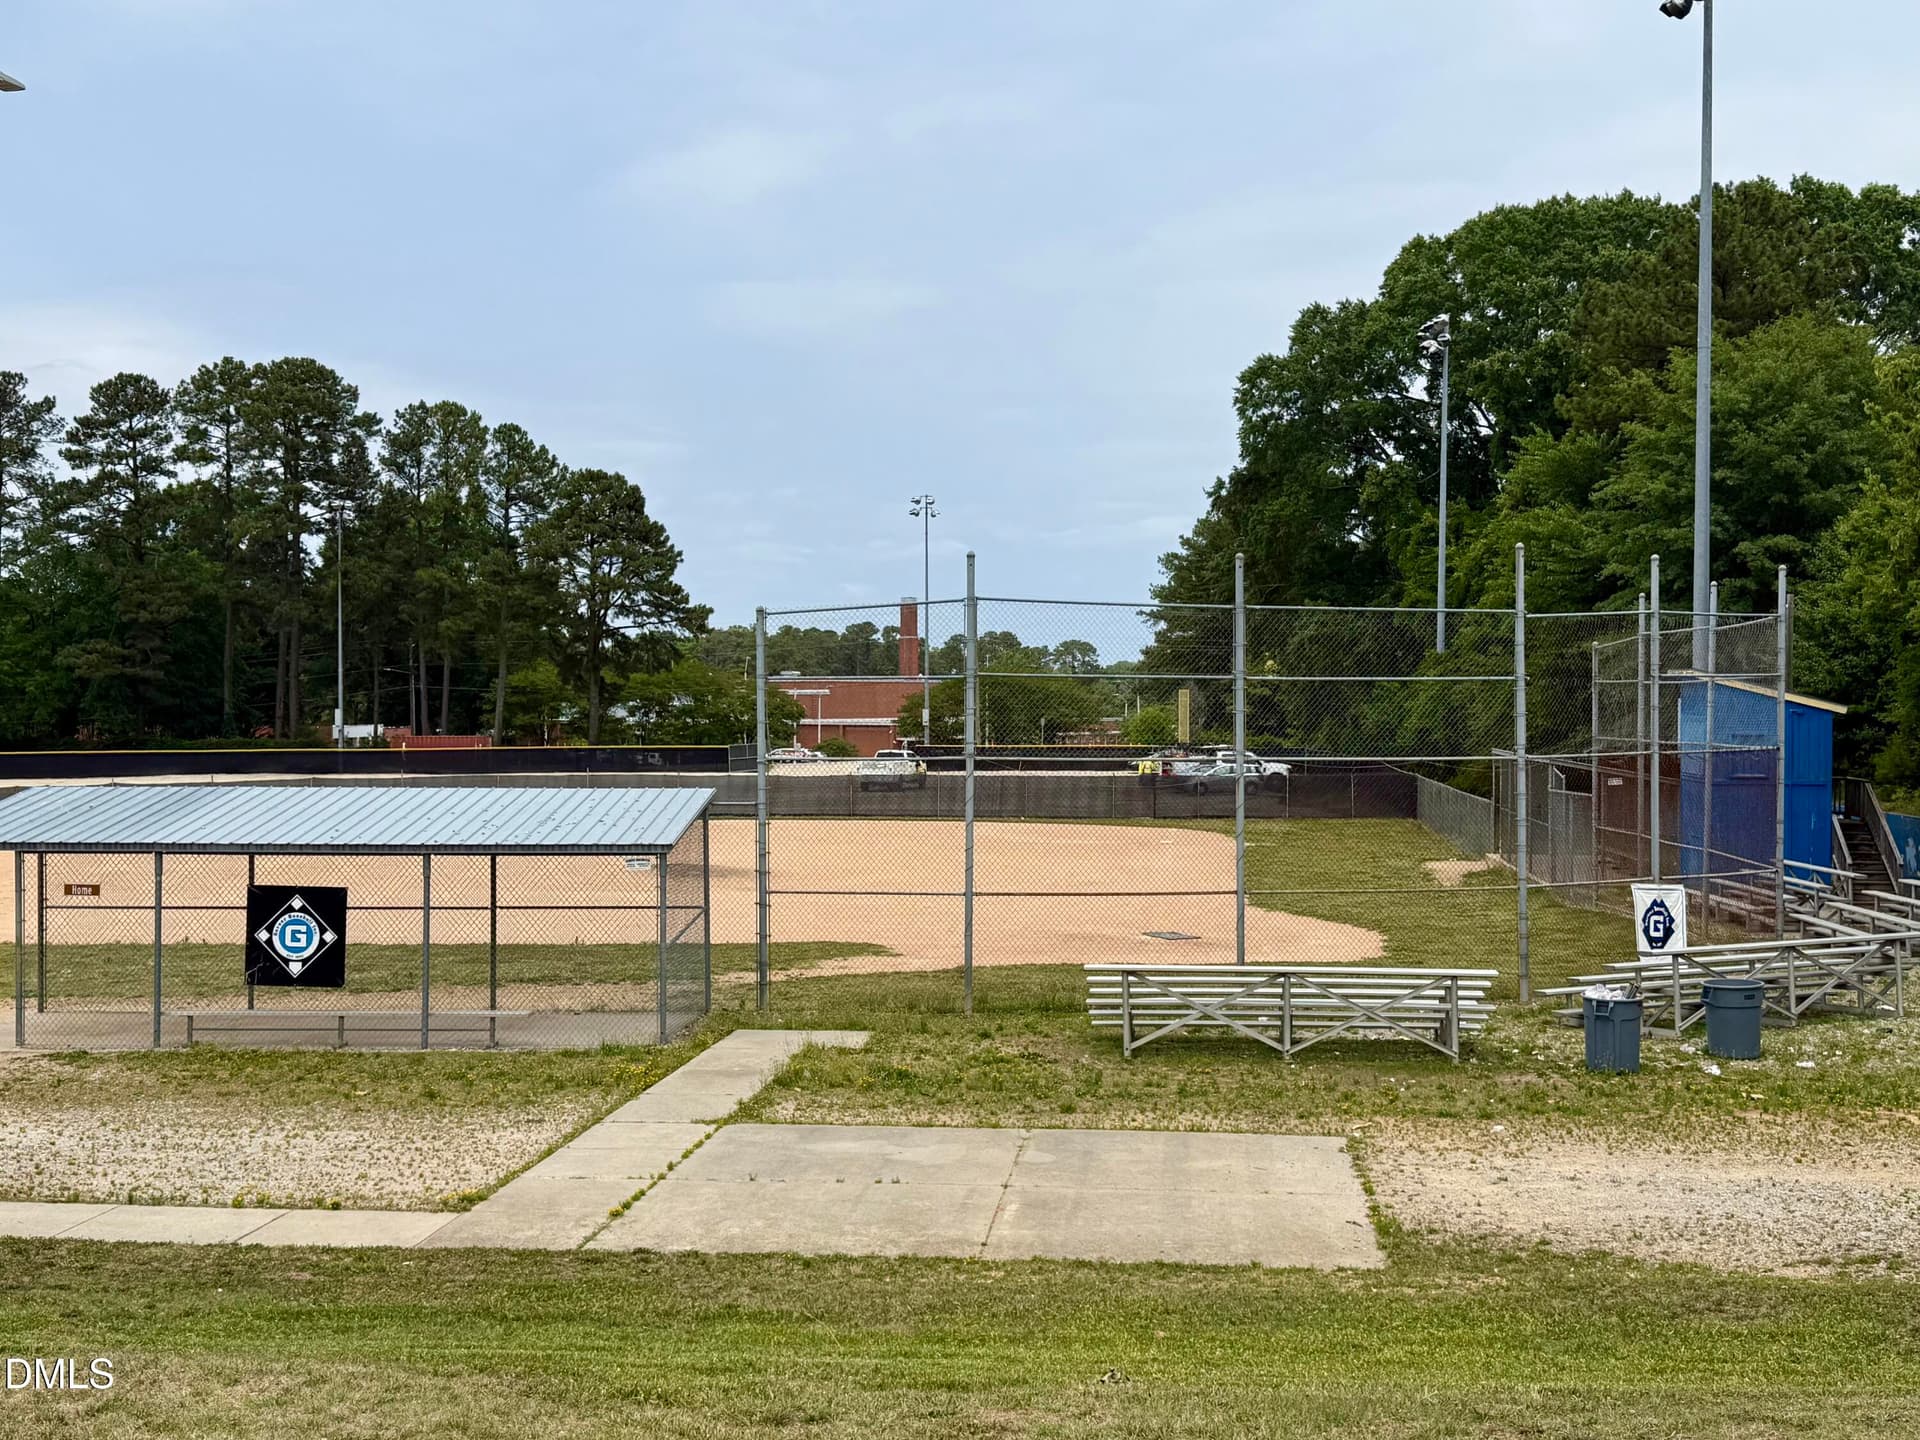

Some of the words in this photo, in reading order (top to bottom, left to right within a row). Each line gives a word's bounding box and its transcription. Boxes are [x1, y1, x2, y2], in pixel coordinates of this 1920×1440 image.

[71, 884, 93, 895] Home
[284, 924, 307, 947] G
[1649, 915, 1664, 938] G
